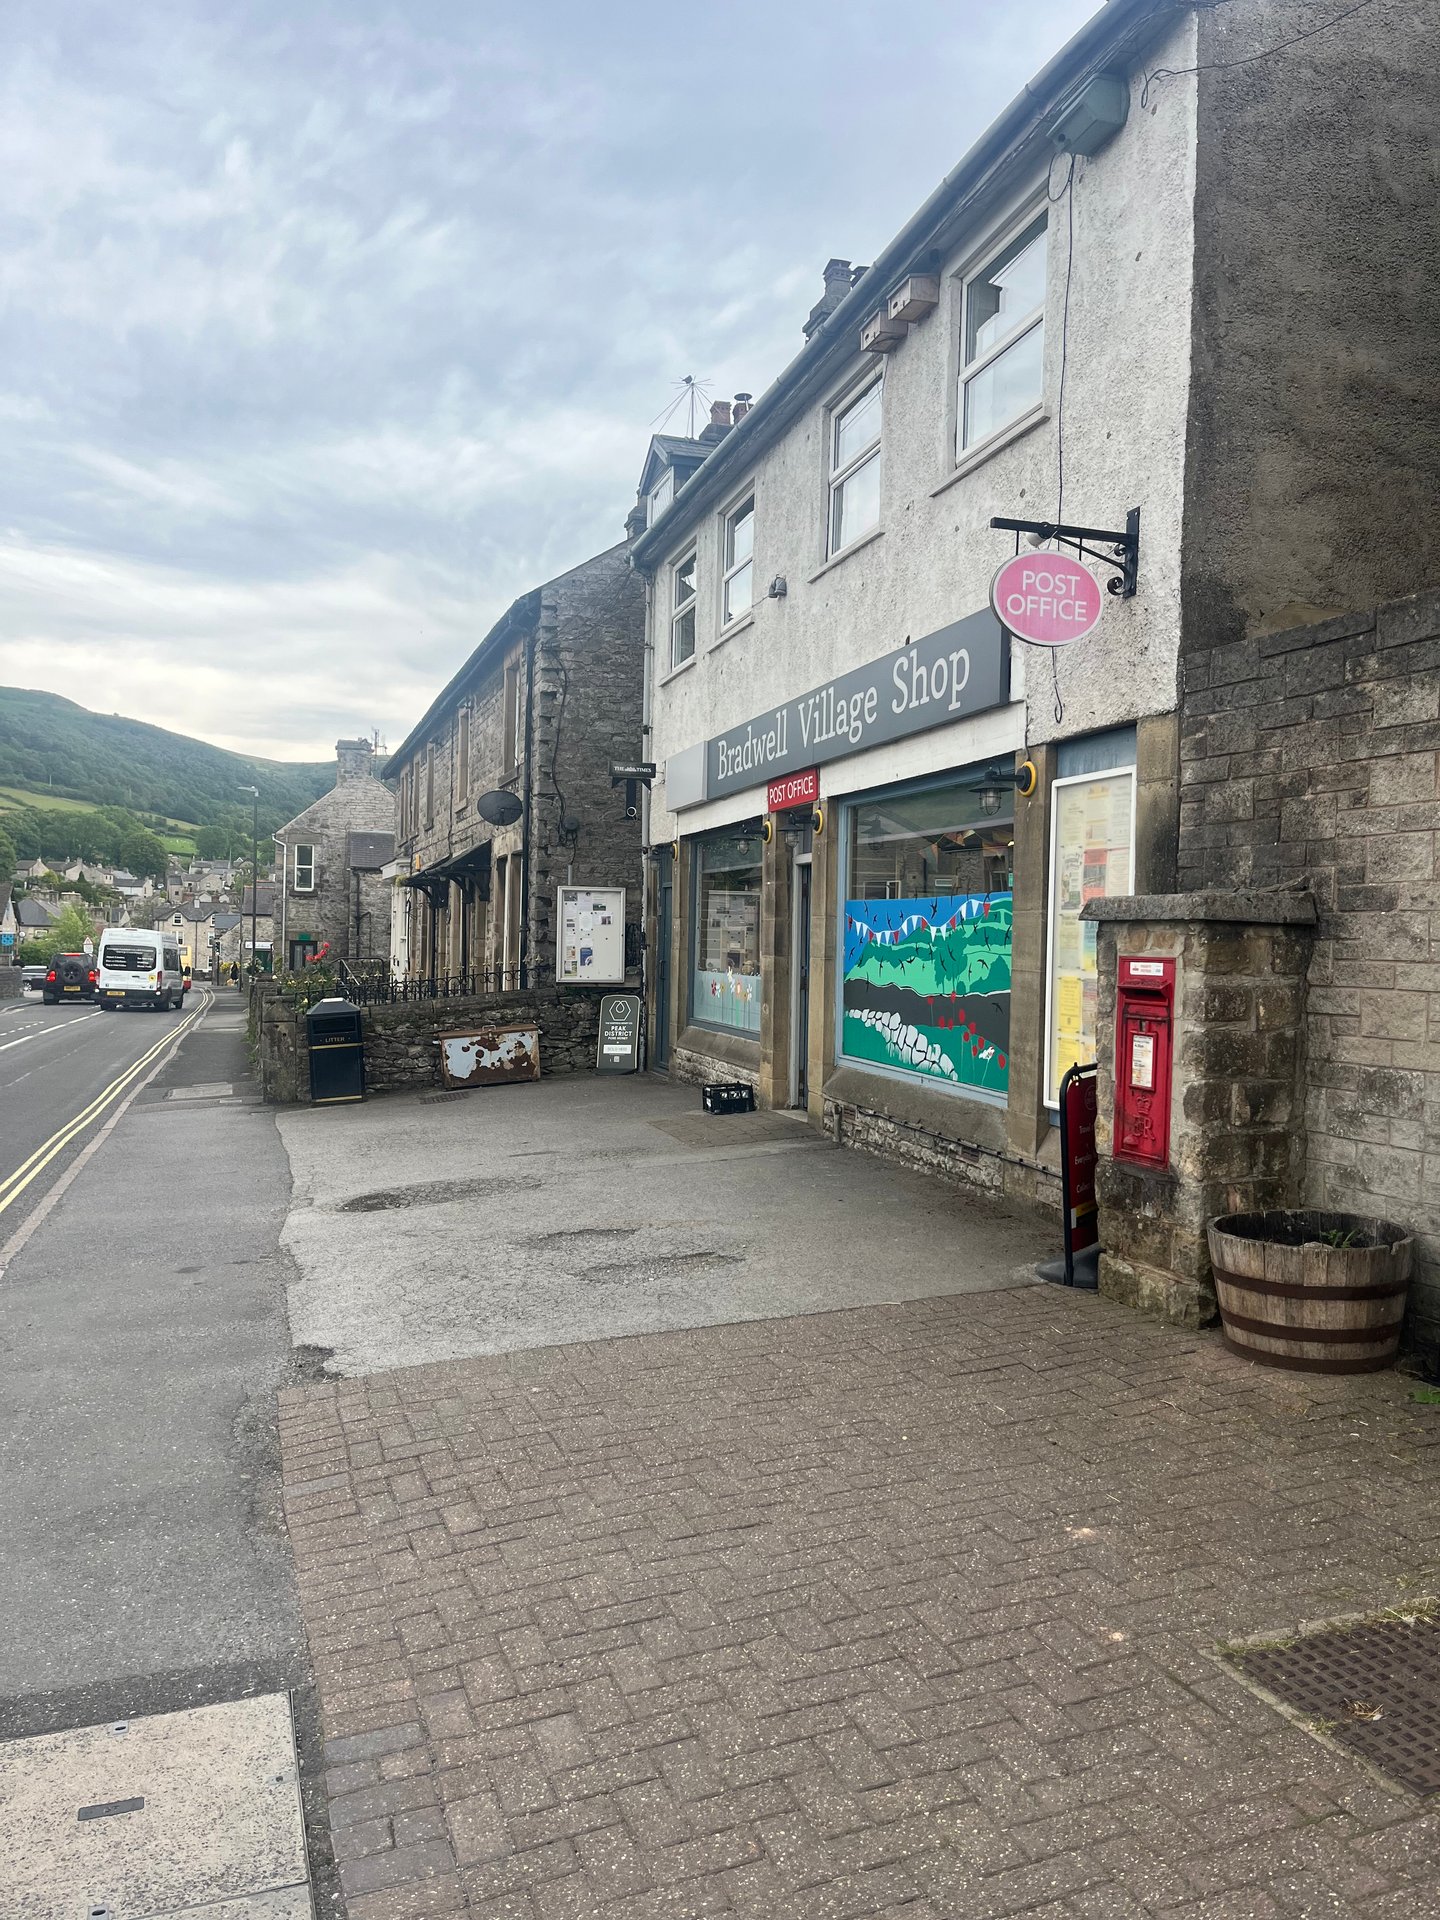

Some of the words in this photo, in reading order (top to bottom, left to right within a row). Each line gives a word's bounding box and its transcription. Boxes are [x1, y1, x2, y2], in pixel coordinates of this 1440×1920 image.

[1022, 570, 1081, 597] POST
[1006, 593, 1088, 622] OFFICE
[717, 708, 788, 781] Bradwell
[797, 686, 878, 749] Village
[891, 648, 970, 714] Shop
[769, 784, 786, 805] POST
[787, 775, 814, 799] OFFICE
